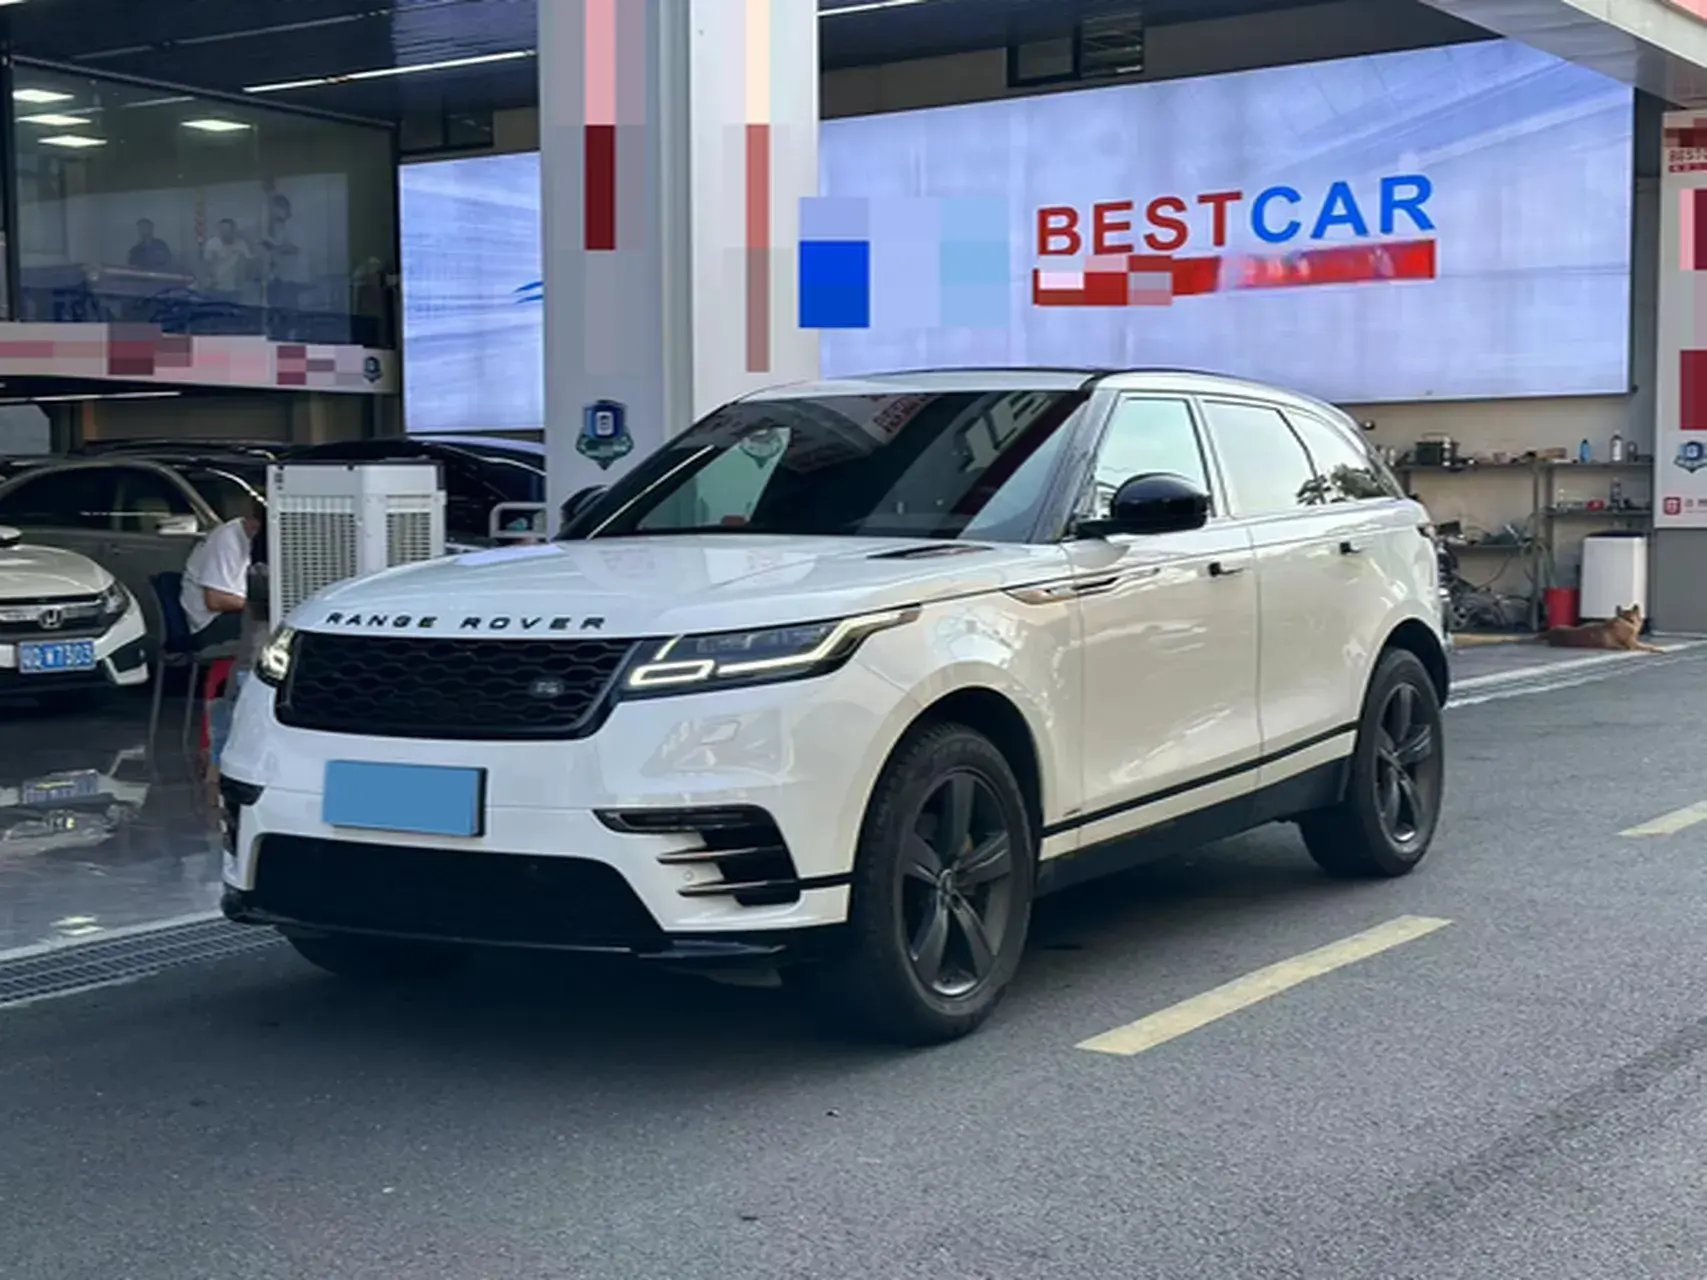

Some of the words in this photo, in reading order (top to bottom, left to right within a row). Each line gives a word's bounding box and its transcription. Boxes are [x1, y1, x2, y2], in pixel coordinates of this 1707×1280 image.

[1037, 174, 1436, 256] BESTCAR
[325, 612, 438, 629] RANGE
[460, 616, 605, 630] ROVER
